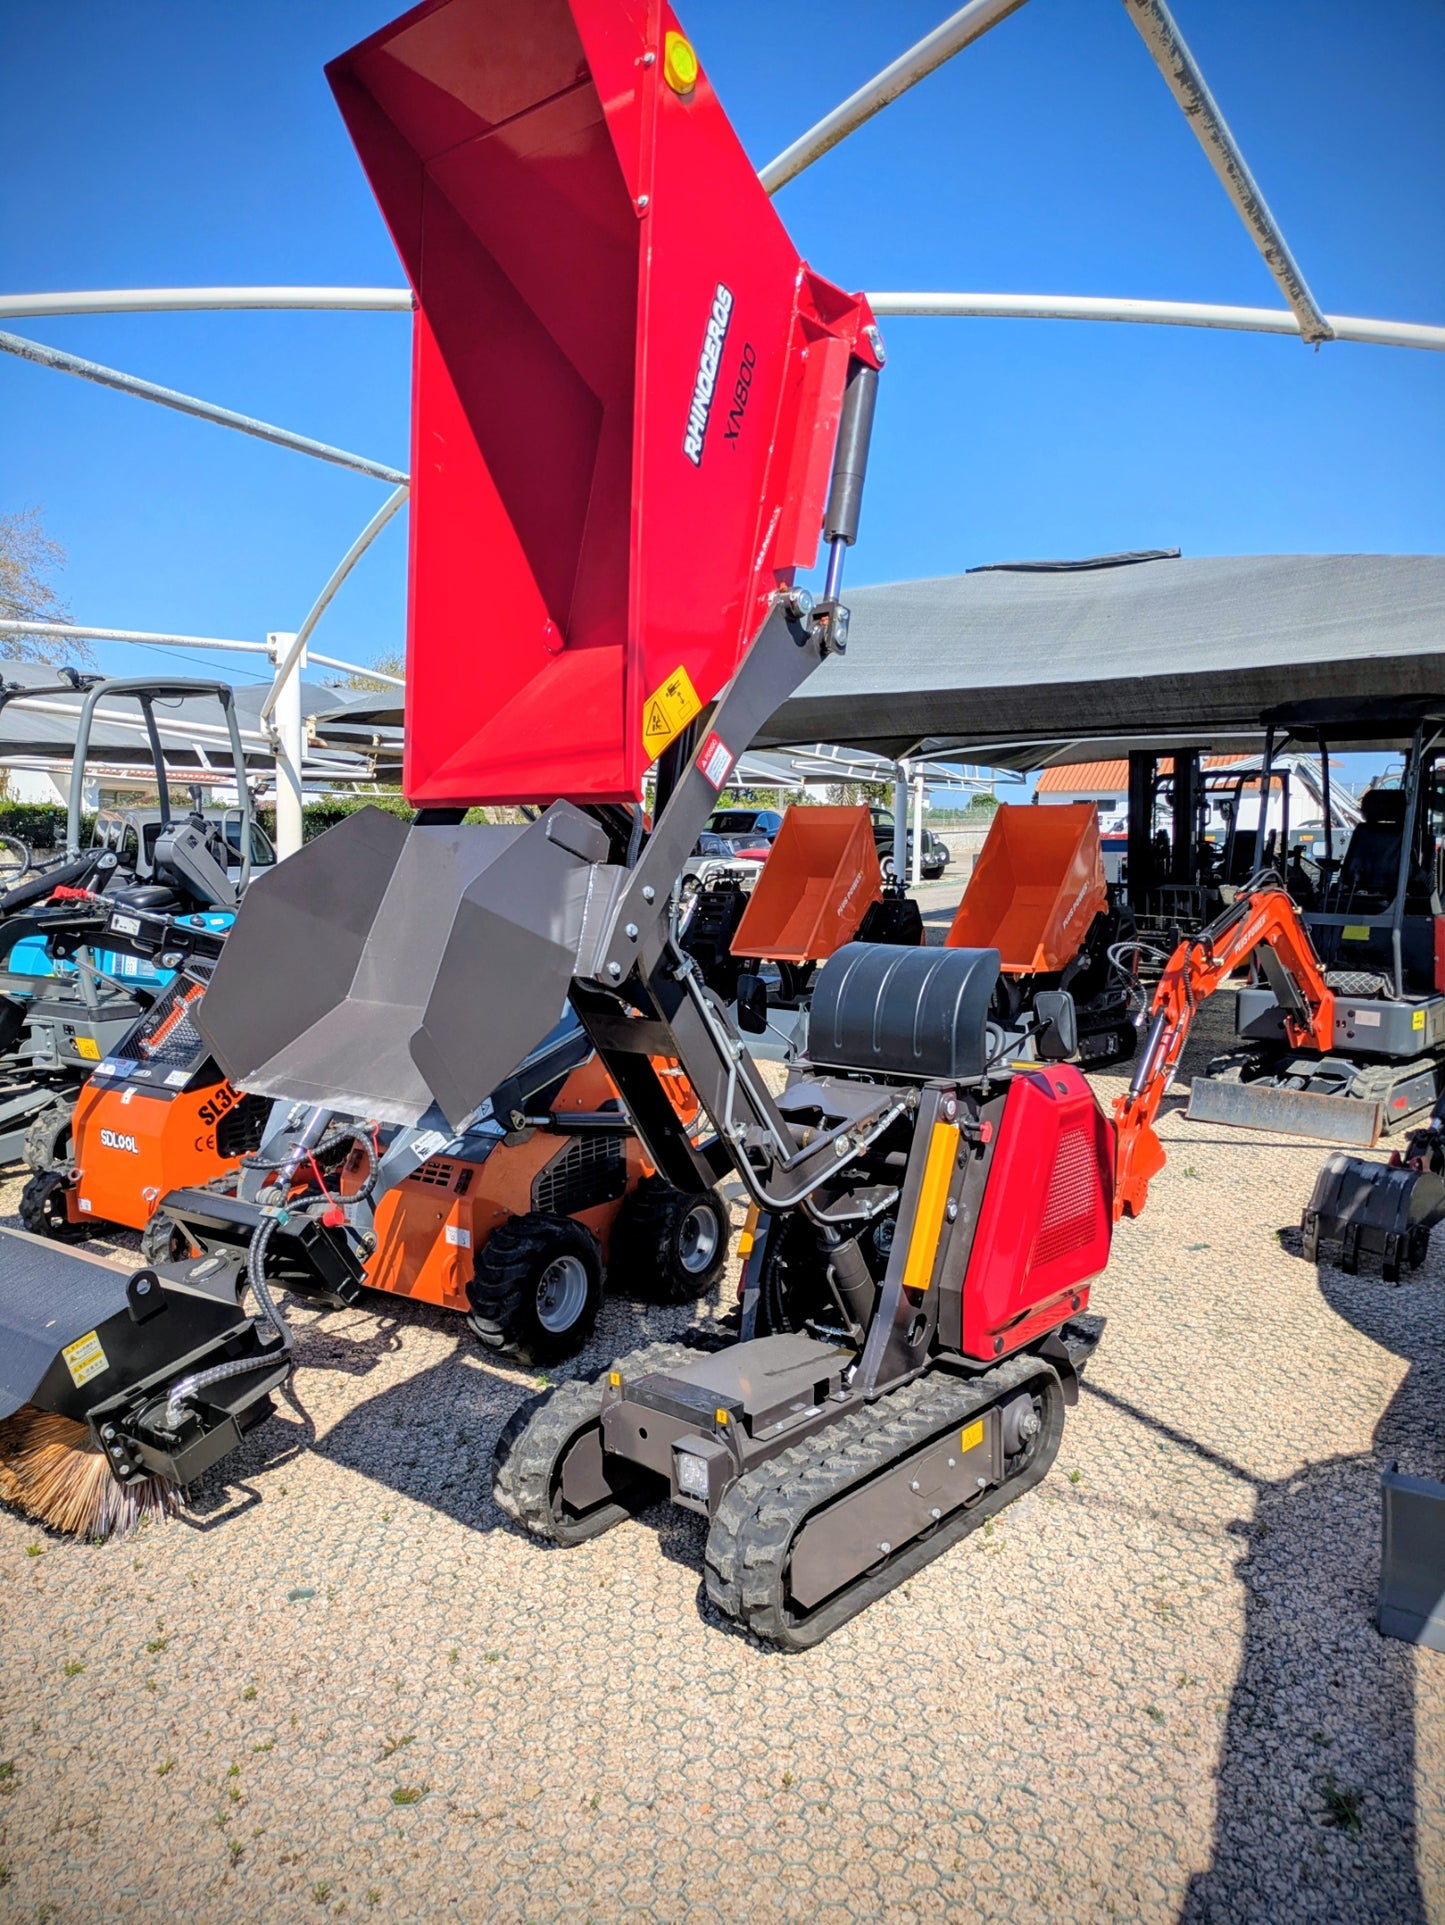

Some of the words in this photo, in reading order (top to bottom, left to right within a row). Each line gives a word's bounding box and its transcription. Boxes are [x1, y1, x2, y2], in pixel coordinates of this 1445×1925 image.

[683, 281, 734, 466] RHINOCEROS
[724, 342, 756, 450] XN800
[837, 896, 849, 916] PLUS
[1063, 907, 1074, 929] PLUS
[1233, 933, 1248, 954] PLUS
[1247, 914, 1267, 941] POWER
[195, 1135, 214, 1151] CE
